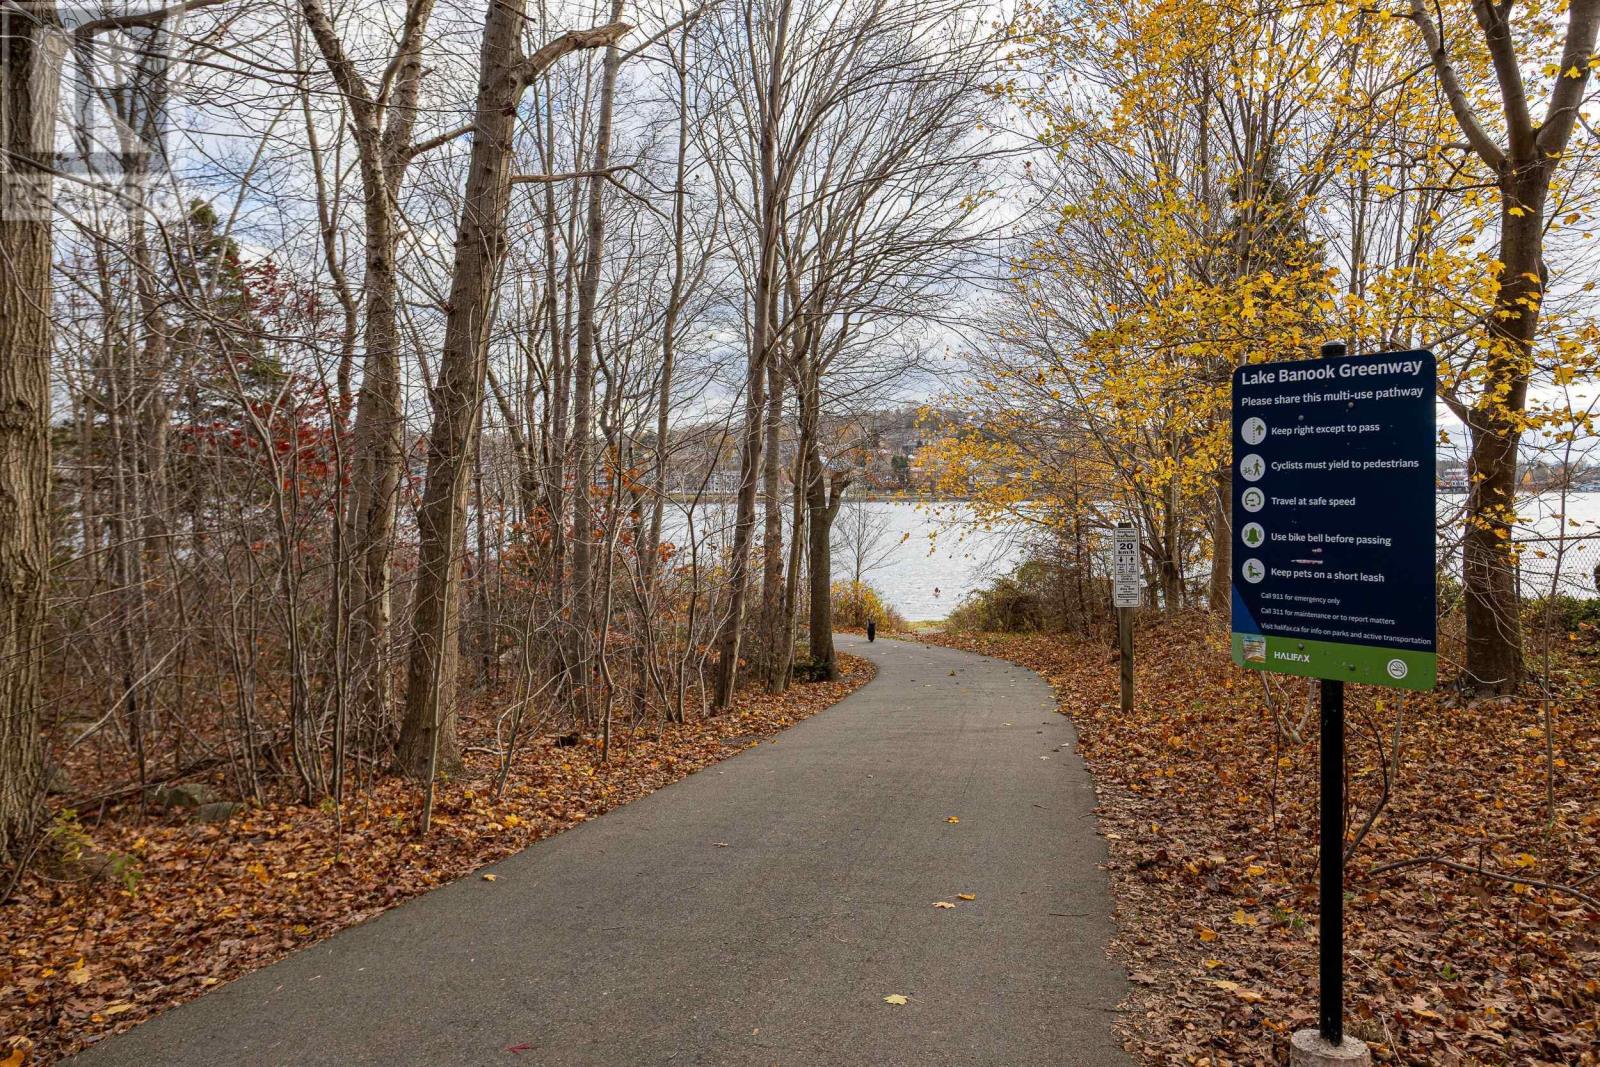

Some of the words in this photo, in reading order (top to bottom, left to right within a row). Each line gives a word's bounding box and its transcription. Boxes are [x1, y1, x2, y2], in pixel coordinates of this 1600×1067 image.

[1242, 371, 1275, 385] Lake
[1279, 365, 1335, 382] Banook
[1339, 360, 1422, 377] Greenway
[1242, 397, 1272, 406] Please
[1275, 394, 1300, 404] share
[1303, 393, 1321, 402] this
[1324, 390, 1373, 401] multi-use
[1376, 386, 1424, 399] pathway
[1271, 427, 1292, 436] Keep
[1294, 426, 1314, 435] right
[1316, 425, 1344, 434] except
[1359, 424, 1380, 432] pass
[1271, 461, 1303, 470] Cyclists
[1305, 461, 1326, 469] must
[1328, 460, 1349, 469] yield
[1352, 460, 1361, 468] to
[1363, 459, 1419, 469] pedestrians
[1271, 497, 1297, 505] Travel
[1309, 497, 1327, 506] safe
[1329, 498, 1356, 506] speed
[1271, 533, 1287, 541] Use
[1289, 533, 1305, 542] bike
[1308, 533, 1323, 542] bell
[1325, 535, 1354, 543] before
[1356, 536, 1392, 546] passing
[1271, 568, 1291, 577] Keep
[1294, 569, 1312, 579] pets
[1334, 572, 1358, 581] short
[1360, 573, 1385, 582] leash
[1294, 596, 1326, 604] emergency
[1327, 597, 1340, 605] only
[1294, 611, 1331, 619] maintenance
[1348, 615, 1368, 623] report
[1369, 617, 1395, 625] matters
[1311, 626, 1323, 634] info
[1333, 629, 1349, 637] parks
[1364, 631, 1382, 640] active
[1383, 635, 1431, 645] transportation
[1274, 651, 1310, 663] HALIFAX
